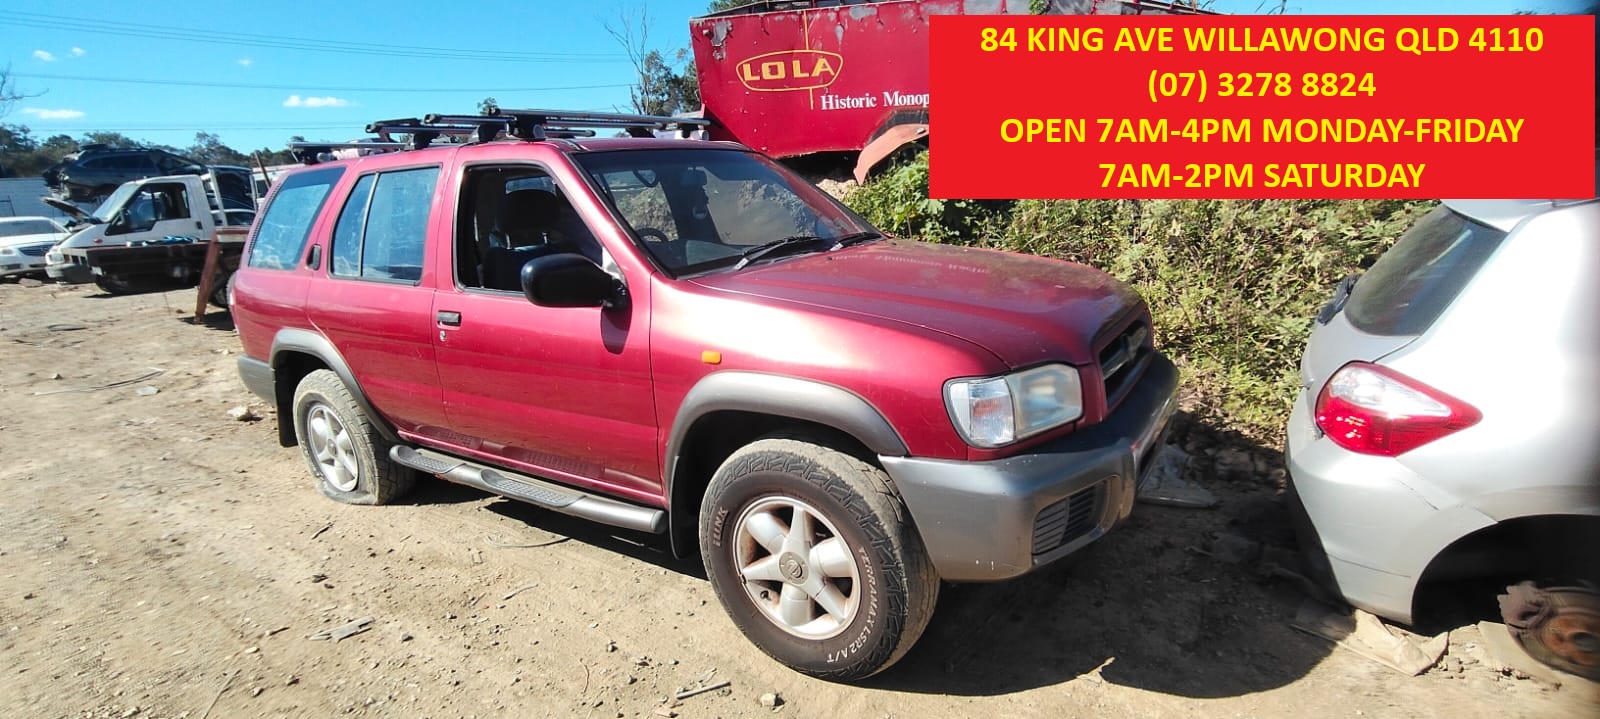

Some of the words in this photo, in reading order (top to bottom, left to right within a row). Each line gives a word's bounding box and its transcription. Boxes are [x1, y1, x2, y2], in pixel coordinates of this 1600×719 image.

[742, 57, 836, 81] LOLA
[820, 92, 877, 110] Historic
[858, 546, 879, 628] TERRAMAX
[849, 625, 872, 654] LSR2
[826, 647, 849, 664] A/T
